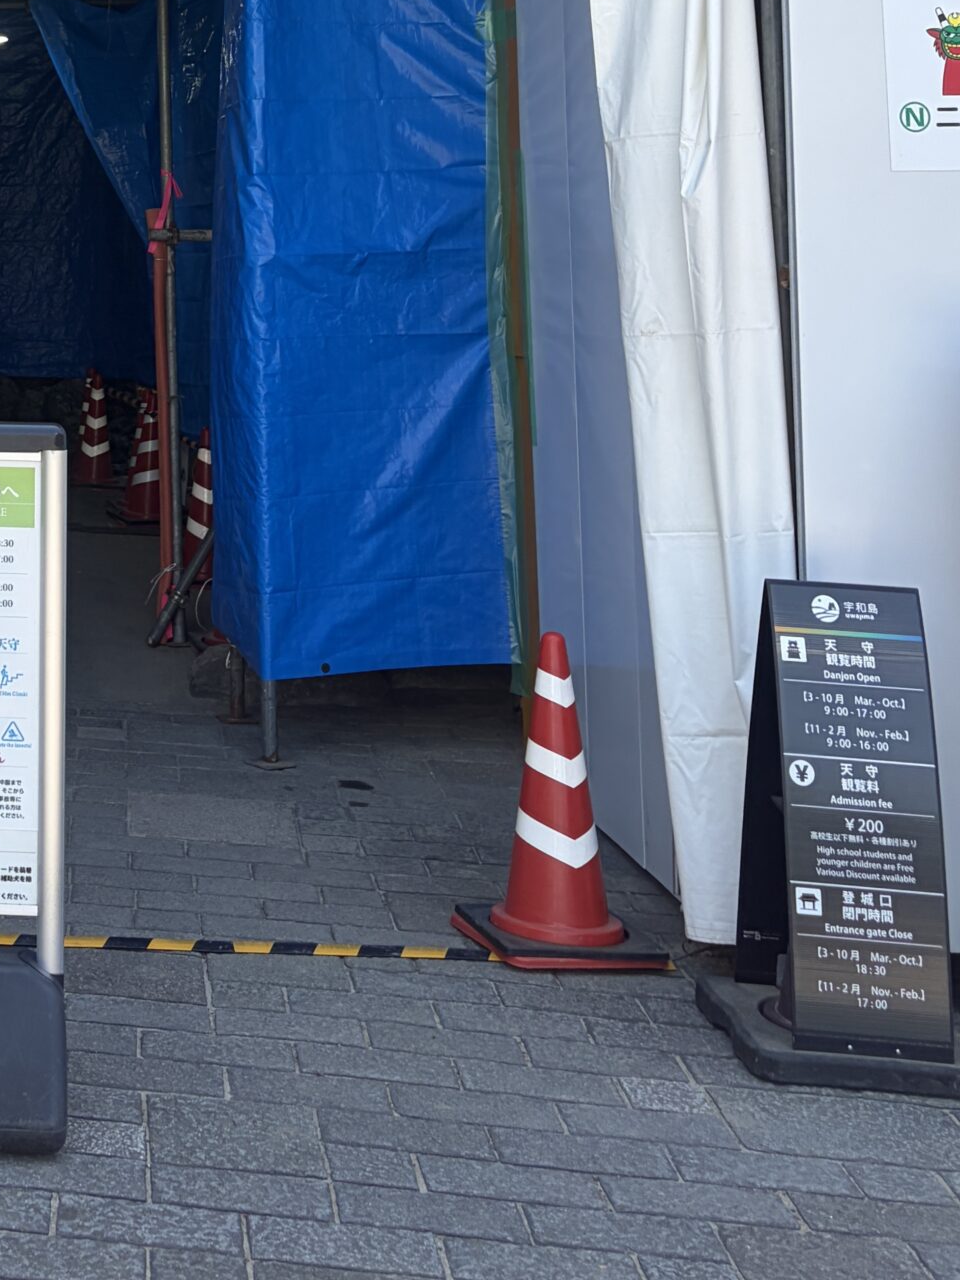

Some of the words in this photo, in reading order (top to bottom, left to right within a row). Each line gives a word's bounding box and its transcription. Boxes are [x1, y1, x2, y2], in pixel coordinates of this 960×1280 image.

[843, 601, 878, 614] 宇和島
[826, 653, 876, 669] 観覧時間
[824, 670, 855, 682] Danjon
[857, 673, 880, 683] Open
[841, 778, 879, 793] 観覧料
[830, 795, 876, 807] Admission
[879, 799, 893, 809] fee
[817, 846, 835, 856] High
[837, 848, 861, 856] school
[863, 851, 896, 860] students
[898, 853, 912, 861] and
[816, 858, 848, 867] younger
[850, 860, 881, 869] children
[897, 864, 914, 872] Free
[816, 868, 844, 877] Various
[846, 870, 879, 879] Discount
[881, 873, 916, 883] available
[825, 923, 864, 934] Entrance
[866, 928, 887, 938] gate
[888, 929, 913, 939] Close
